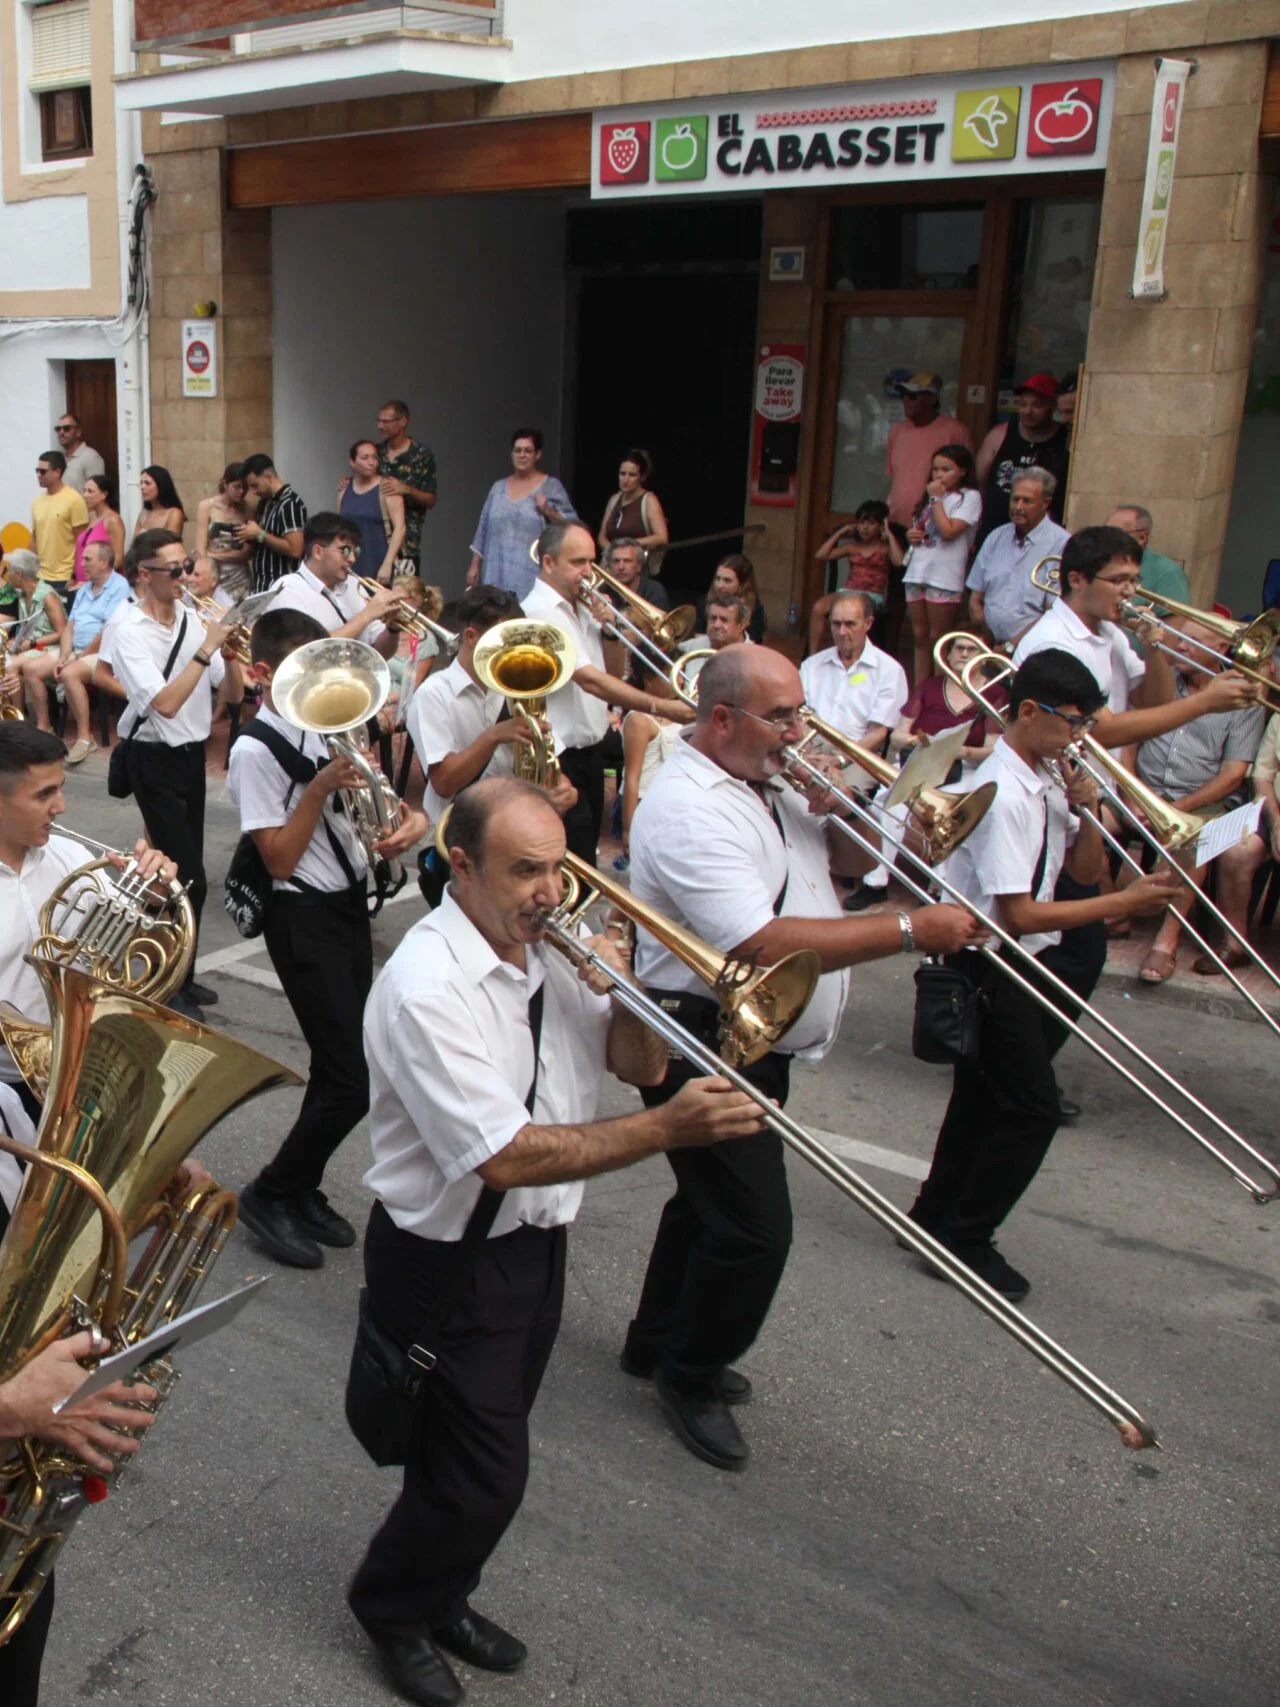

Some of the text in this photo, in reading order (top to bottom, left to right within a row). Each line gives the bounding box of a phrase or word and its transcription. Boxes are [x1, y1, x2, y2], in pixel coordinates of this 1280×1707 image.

[717, 113, 744, 138] EL
[716, 122, 946, 176] CABASSET
[768, 366, 793, 376] Para
[764, 375, 795, 385] llevar
[766, 387, 794, 397] Take
[763, 398, 794, 407] away
